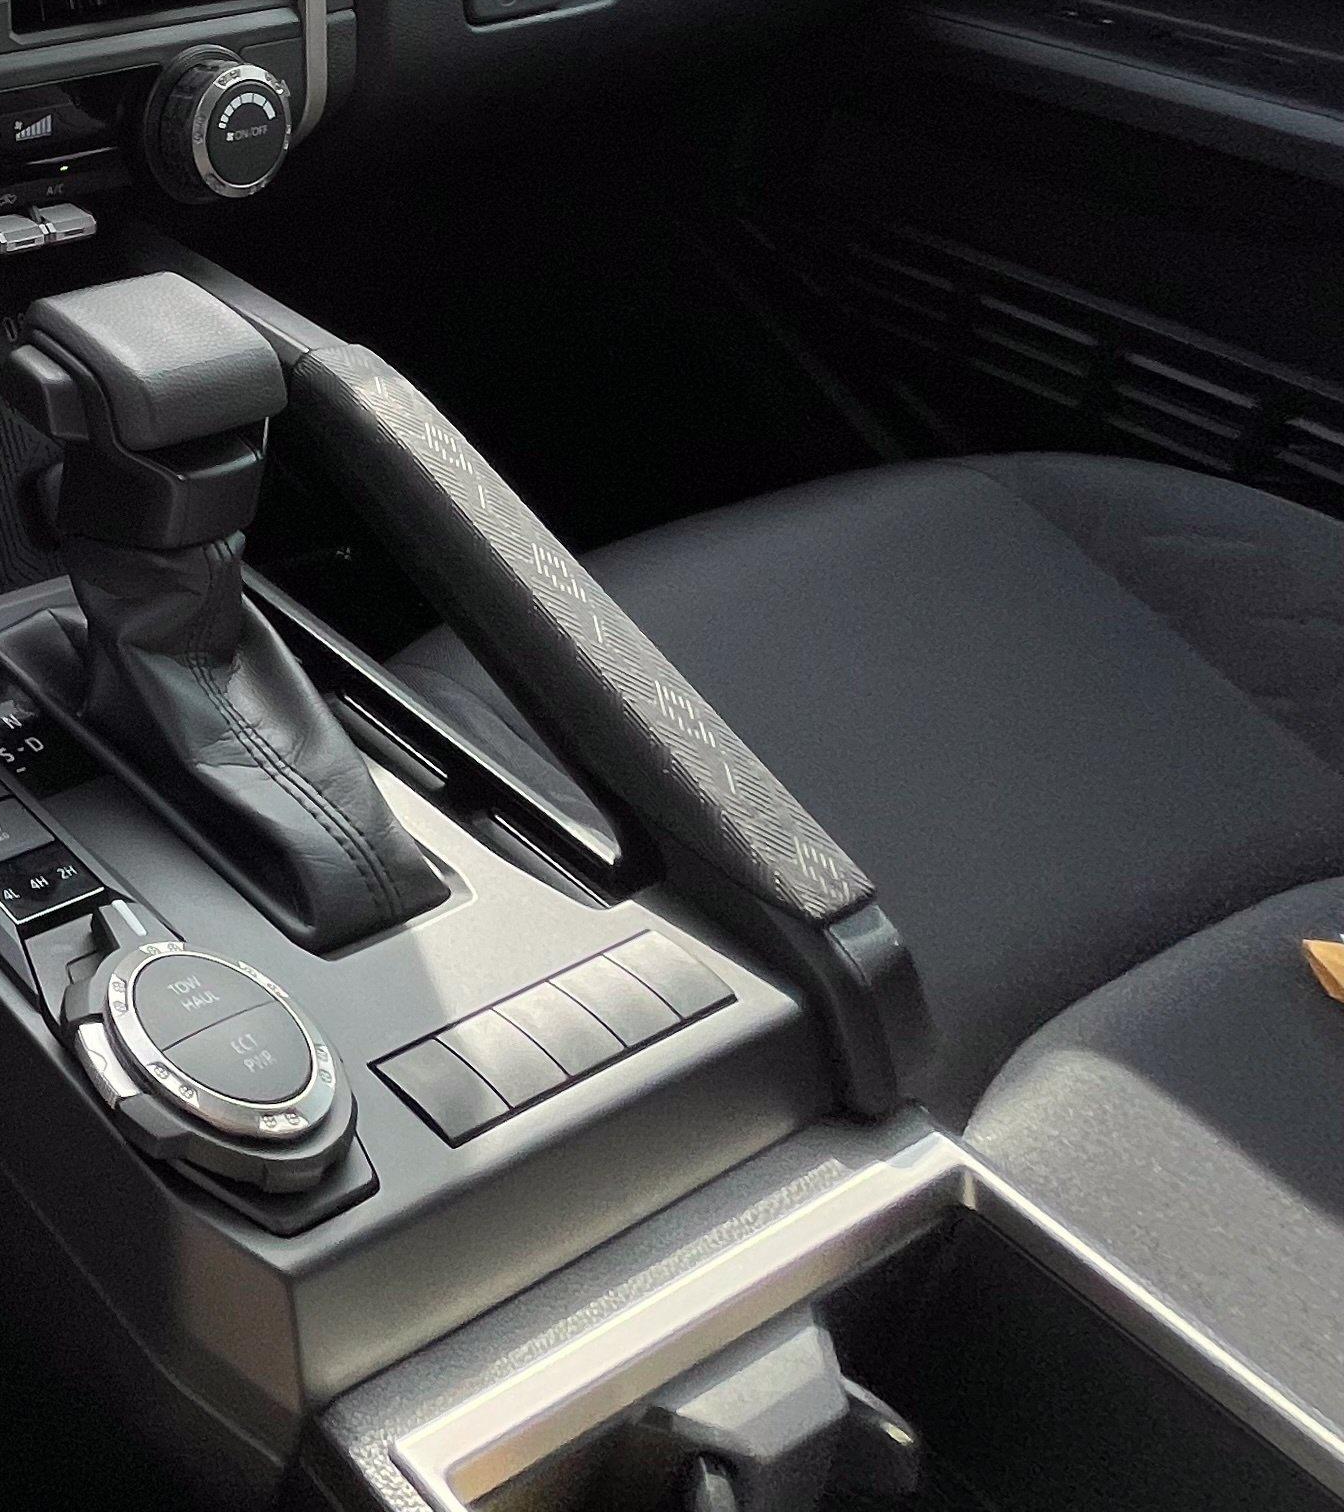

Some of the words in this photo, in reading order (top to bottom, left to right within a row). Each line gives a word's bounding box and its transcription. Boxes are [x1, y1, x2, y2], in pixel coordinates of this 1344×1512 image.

[46, 184, 64, 196] A/C
[2, 713, 23, 730] N
[24, 736, 45, 753] D
[56, 865, 78, 880] 2H
[29, 875, 50, 890] 4H
[2, 887, 21, 901] 4L
[168, 974, 202, 995] TOW
[179, 989, 220, 1013] HAUL
[230, 1032, 260, 1055] ECT
[243, 1050, 278, 1073] PWR
